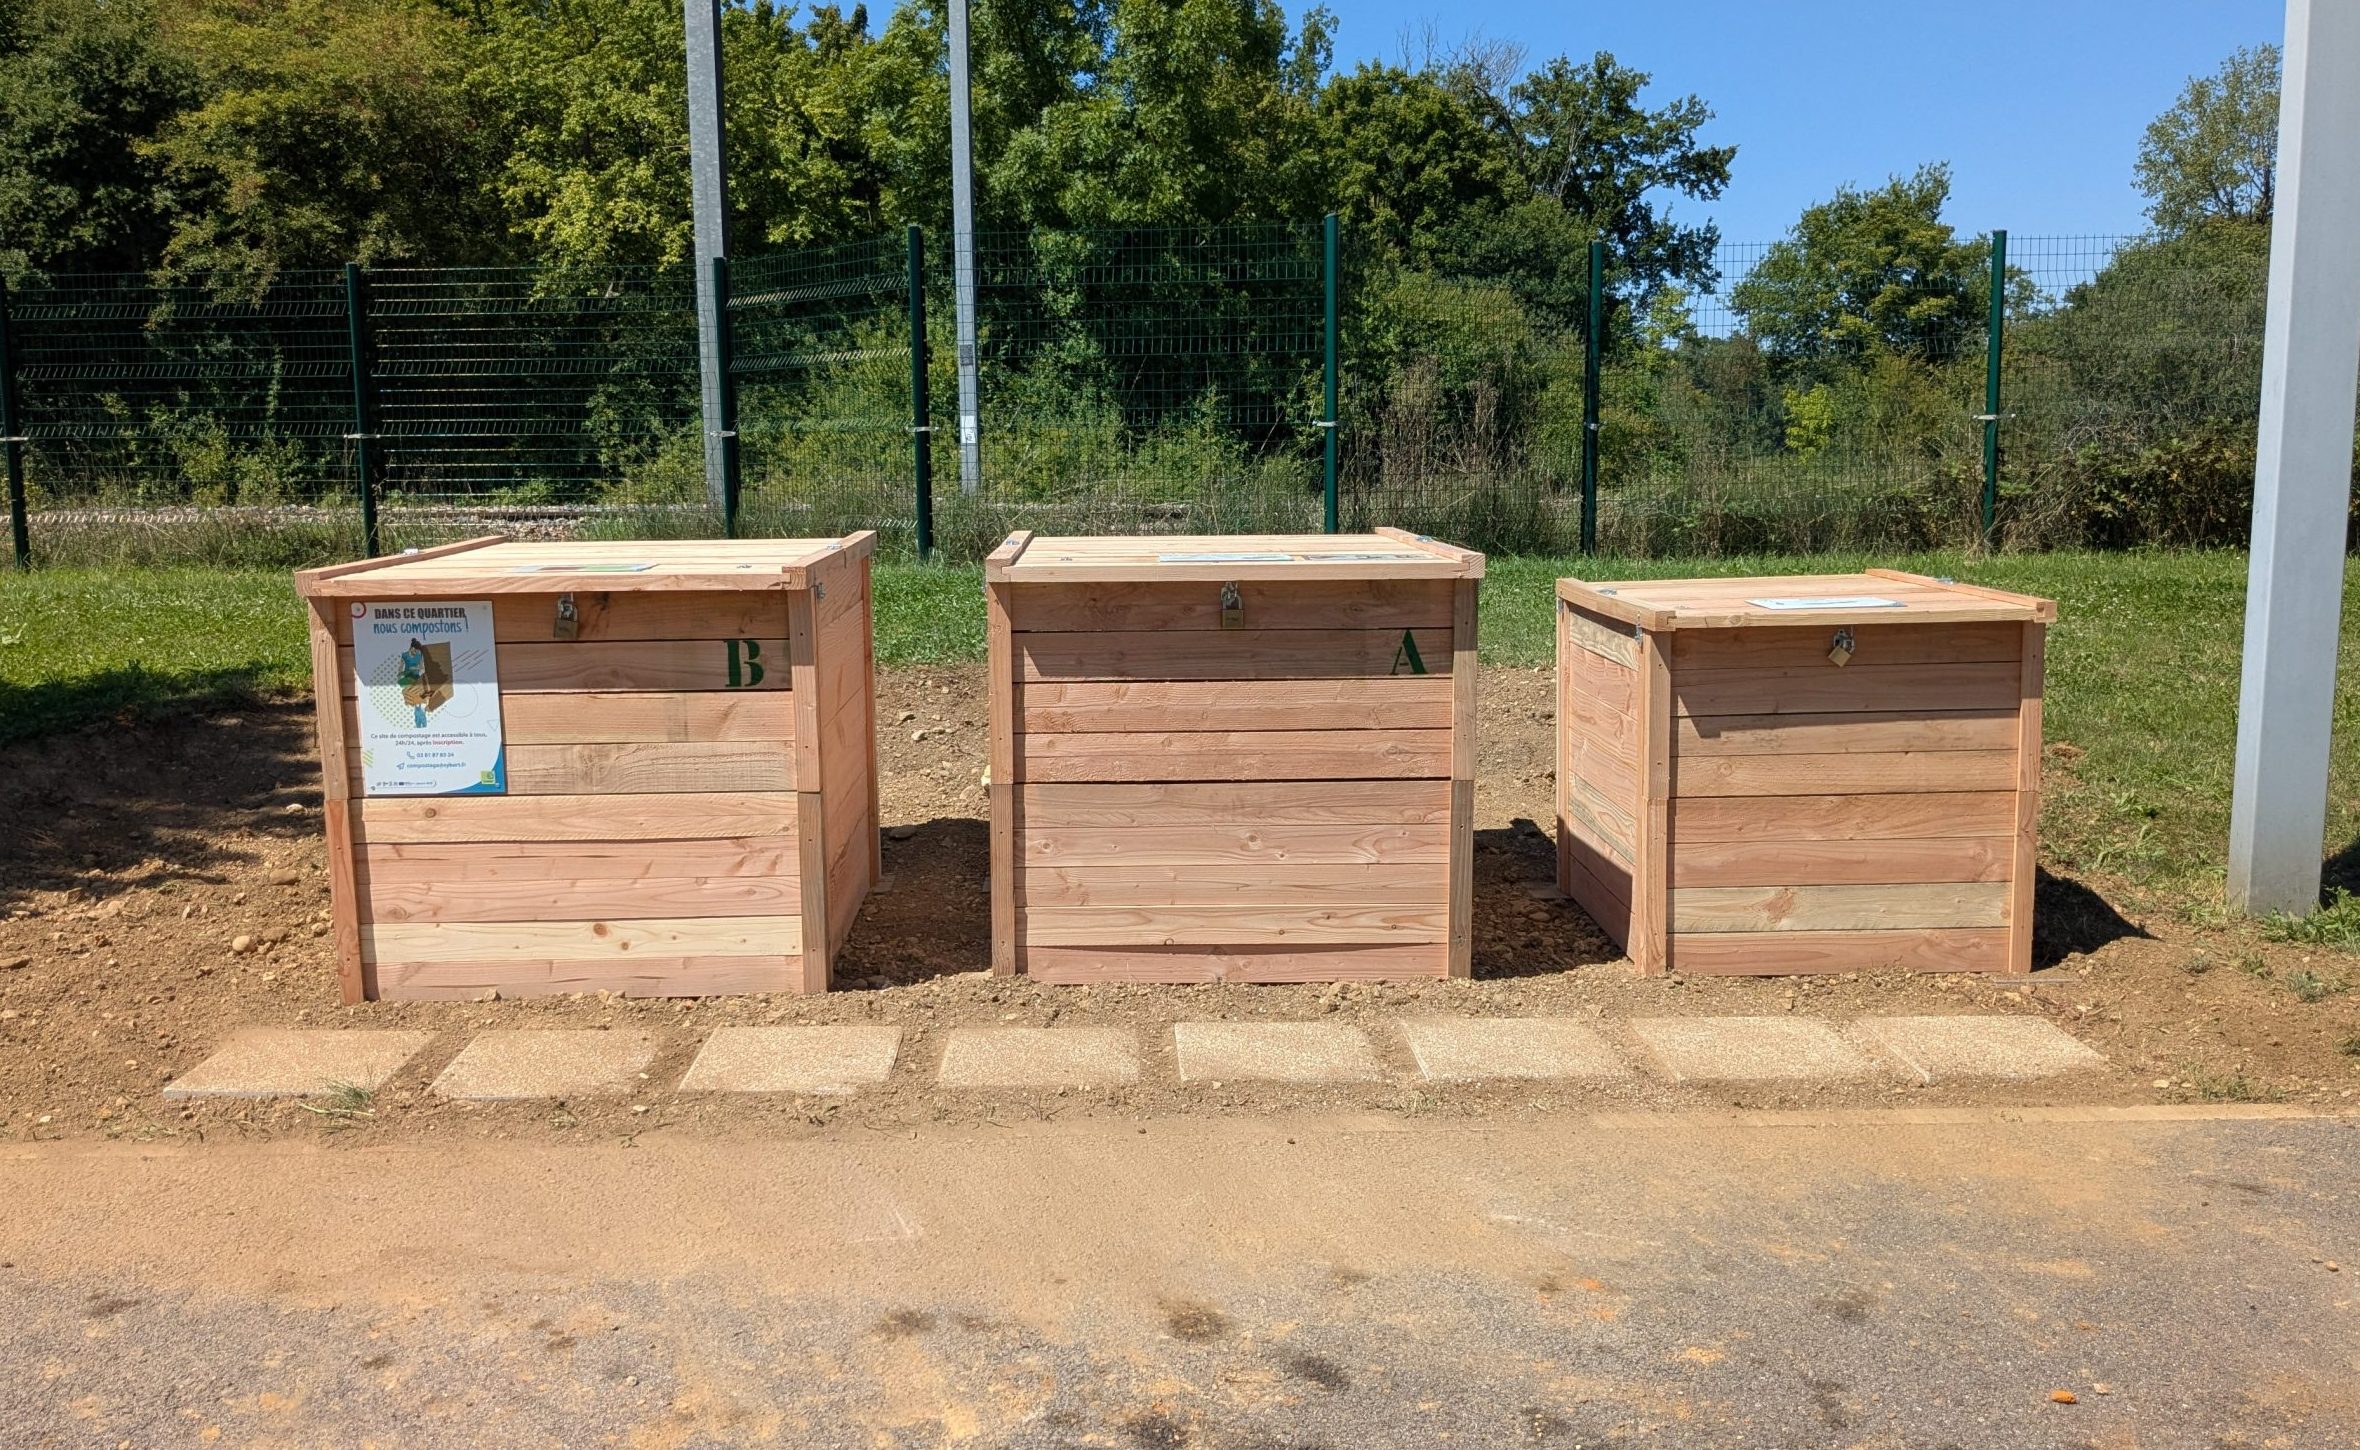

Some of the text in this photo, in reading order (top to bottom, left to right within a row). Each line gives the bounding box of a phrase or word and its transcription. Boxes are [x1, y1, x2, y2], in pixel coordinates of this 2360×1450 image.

[373, 623, 398, 634] nous
[400, 619, 463, 640] compostons
[374, 607, 466, 619] DANS CE QUARTIER
[723, 638, 765, 688] B
[1390, 628, 1429, 676] A
